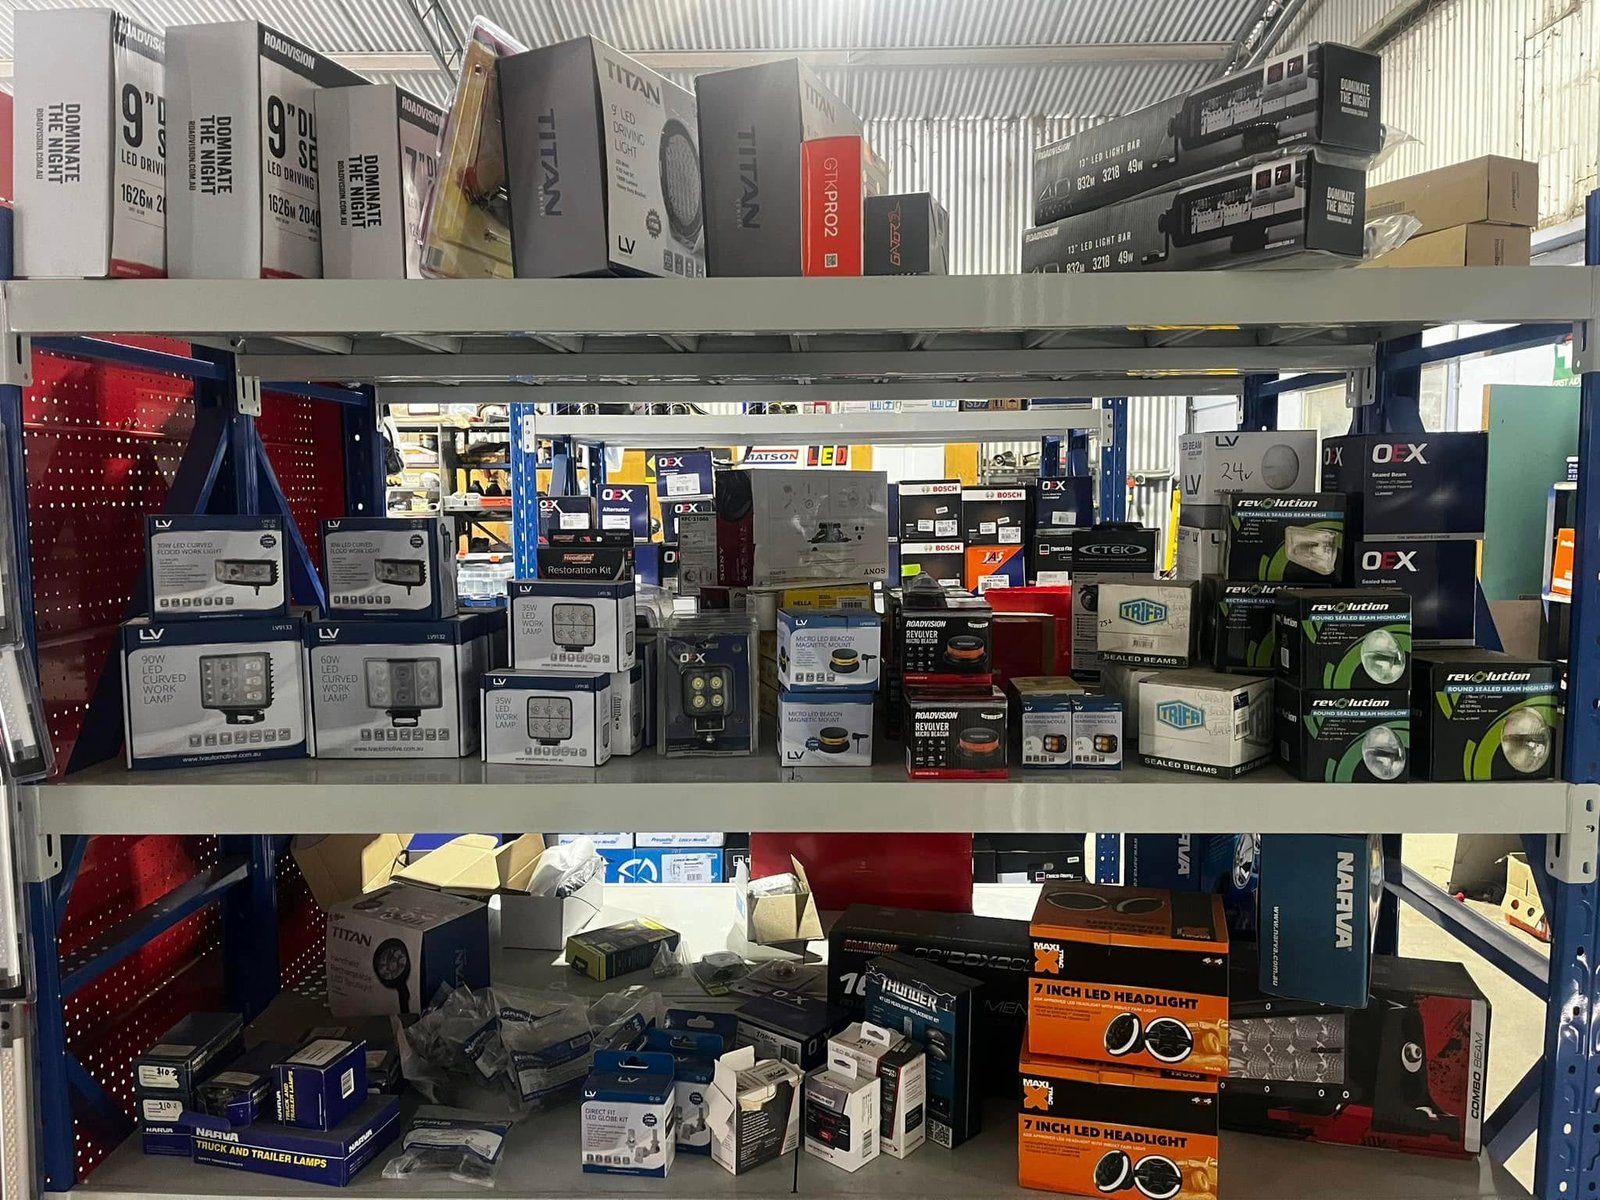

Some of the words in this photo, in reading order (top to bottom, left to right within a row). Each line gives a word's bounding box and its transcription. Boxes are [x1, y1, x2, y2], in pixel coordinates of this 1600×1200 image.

[264, 31, 315, 70] ROADVISION
[604, 58, 660, 105] TITAN
[1340, 78, 1370, 96] DOMINATE
[804, 80, 835, 123] TITAN
[1340, 90, 1351, 104] THE
[1352, 93, 1370, 109] NIGHT
[49, 103, 63, 132] THE
[402, 96, 441, 126] ROADVISIO
[200, 115, 215, 145] THE
[613, 120, 646, 146] DRIVING
[65, 104, 81, 183] DOMINATE
[614, 140, 638, 159] LIGHT
[1079, 157, 1089, 168] 13"
[1091, 153, 1102, 164] LED
[1105, 144, 1124, 159] LIGHT
[1127, 139, 1141, 151] BAR
[49, 138, 63, 184] NIGHT
[217, 116, 232, 194] DOMINATE
[538, 108, 562, 216] TITAN
[201, 150, 216, 195] NIGHT
[267, 160, 281, 178] LED
[284, 167, 315, 190] DRIVING
[349, 154, 363, 182] THE
[738, 126, 760, 229] TITAN
[1077, 175, 1095, 190] 832M
[1102, 165, 1120, 182] 3218
[1128, 159, 1143, 174] 49W
[364, 155, 381, 227] DOMINATE
[823, 157, 839, 237] GTKPRO2
[269, 194, 296, 219] 1626M
[350, 186, 366, 229] NIGHT
[618, 234, 636, 255] LV
[1068, 244, 1078, 254] 13"
[1081, 241, 1092, 251] LED
[1095, 235, 1114, 248] LIGHT
[1117, 232, 1131, 243] BAR
[1215, 435, 1239, 447] LV
[658, 457, 684, 468] OEX
[807, 445, 848, 466] LED
[1372, 443, 1428, 464] OEX
[1042, 480, 1066, 491] OEX
[1185, 474, 1201, 495] LV
[602, 489, 634, 502] OEX
[1238, 498, 1318, 509] revolution
[674, 503, 699, 513] OEX
[155, 520, 173, 528] LV
[983, 552, 1004, 563] JAS
[1091, 545, 1130, 554] CTEK
[548, 566, 598, 574] Restoration
[600, 566, 611, 574] Kit
[1362, 551, 1417, 572] OEX
[519, 585, 532, 593] LV
[521, 604, 538, 612] 35W
[522, 612, 536, 620] LED
[1122, 599, 1165, 623] TRIFA
[139, 628, 164, 640] LV
[319, 628, 339, 639] LV
[522, 620, 544, 628] WORK
[906, 620, 946, 628] ROADVISION
[906, 630, 938, 638] REVOLVER
[141, 655, 166, 664] 90W
[321, 655, 341, 664] 60W
[1103, 652, 1141, 663] SEALED
[1143, 656, 1177, 665] BEAMS
[142, 665, 162, 675] LED
[143, 674, 187, 684] CURVED
[321, 665, 338, 674] LED
[322, 675, 358, 683] CURVED
[143, 684, 176, 694] WORK
[322, 684, 350, 692] WORK
[323, 693, 348, 702] LAMP
[144, 694, 174, 705] LAMP
[1160, 703, 1198, 726] TRIFA
[1144, 757, 1180, 769] SEALED
[1183, 761, 1217, 775] BEAMS
[1335, 851, 1354, 948] NARVA
[332, 926, 373, 947] TITAN
[1034, 942, 1059, 951] MAXI
[1272, 906, 1280, 986] www.narva.com.au
[880, 977, 938, 1014] THUNDER
[1034, 983, 1043, 994] 7
[1046, 984, 1081, 998] INCH
[1085, 988, 1111, 1000] LED
[1114, 991, 1198, 1010] HEADLIGHT
[1474, 1032, 1484, 1070] BEAM
[1023, 1078, 1049, 1088] MAXI
[1471, 1072, 1481, 1119] COMBO
[196, 1127, 239, 1143] NARVA
[1024, 1119, 1033, 1130] 7
[1036, 1120, 1071, 1135] INCH
[1074, 1125, 1100, 1138] LED
[1104, 1129, 1187, 1148] HEADLIGHT
[196, 1141, 227, 1153] TRUCK
[229, 1145, 249, 1157] AND
[251, 1150, 291, 1164] TRAILER
[294, 1157, 327, 1169] LAMPS
